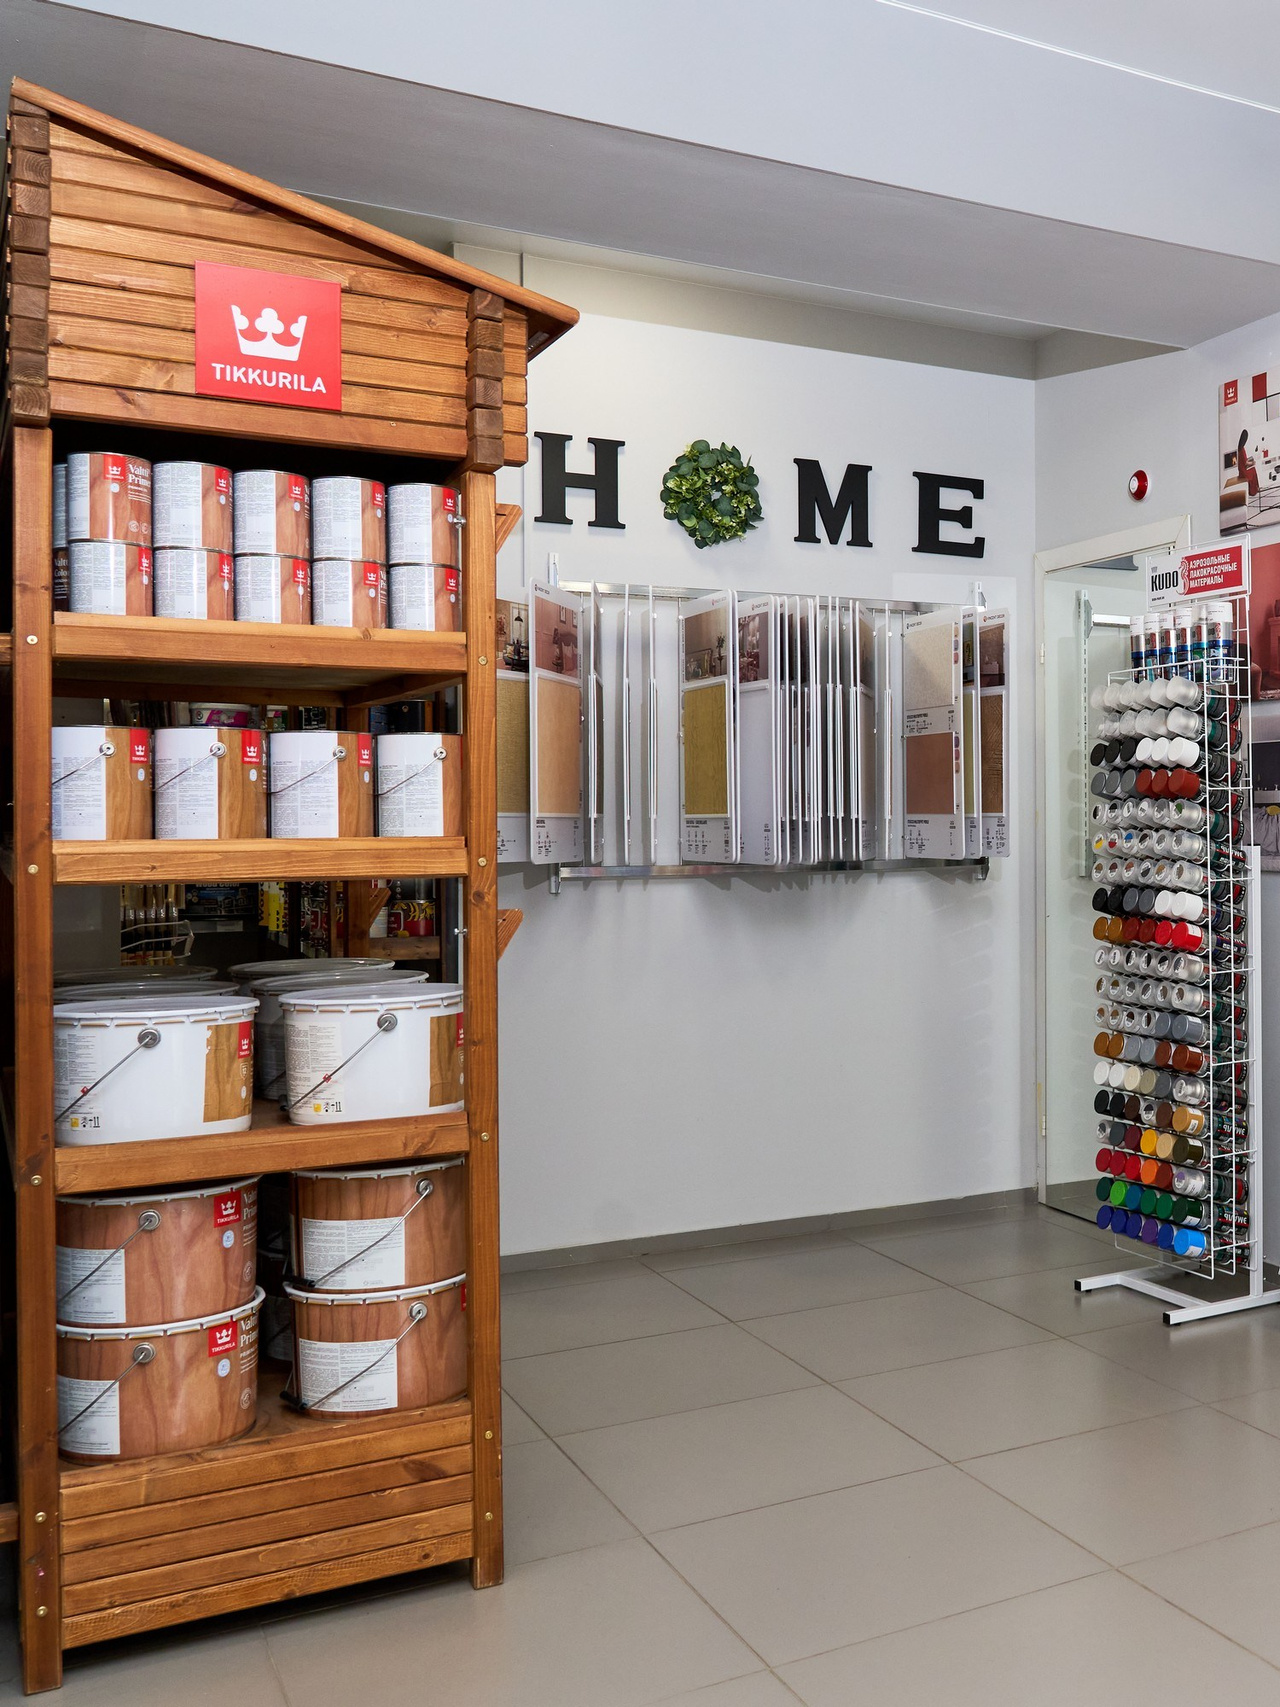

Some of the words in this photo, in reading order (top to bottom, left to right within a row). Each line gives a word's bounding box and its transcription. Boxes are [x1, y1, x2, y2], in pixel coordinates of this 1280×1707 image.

[211, 363, 327, 394] TIKKURILA
[1189, 553, 1231, 569] АЭРОЗОЛЬНЫЕ
[1189, 562, 1237, 579] ЛАКОКРАСОЧНЫЕ
[1151, 570, 1179, 592] KUDO
[1189, 574, 1224, 588] МАТЕРИАЛЫ
